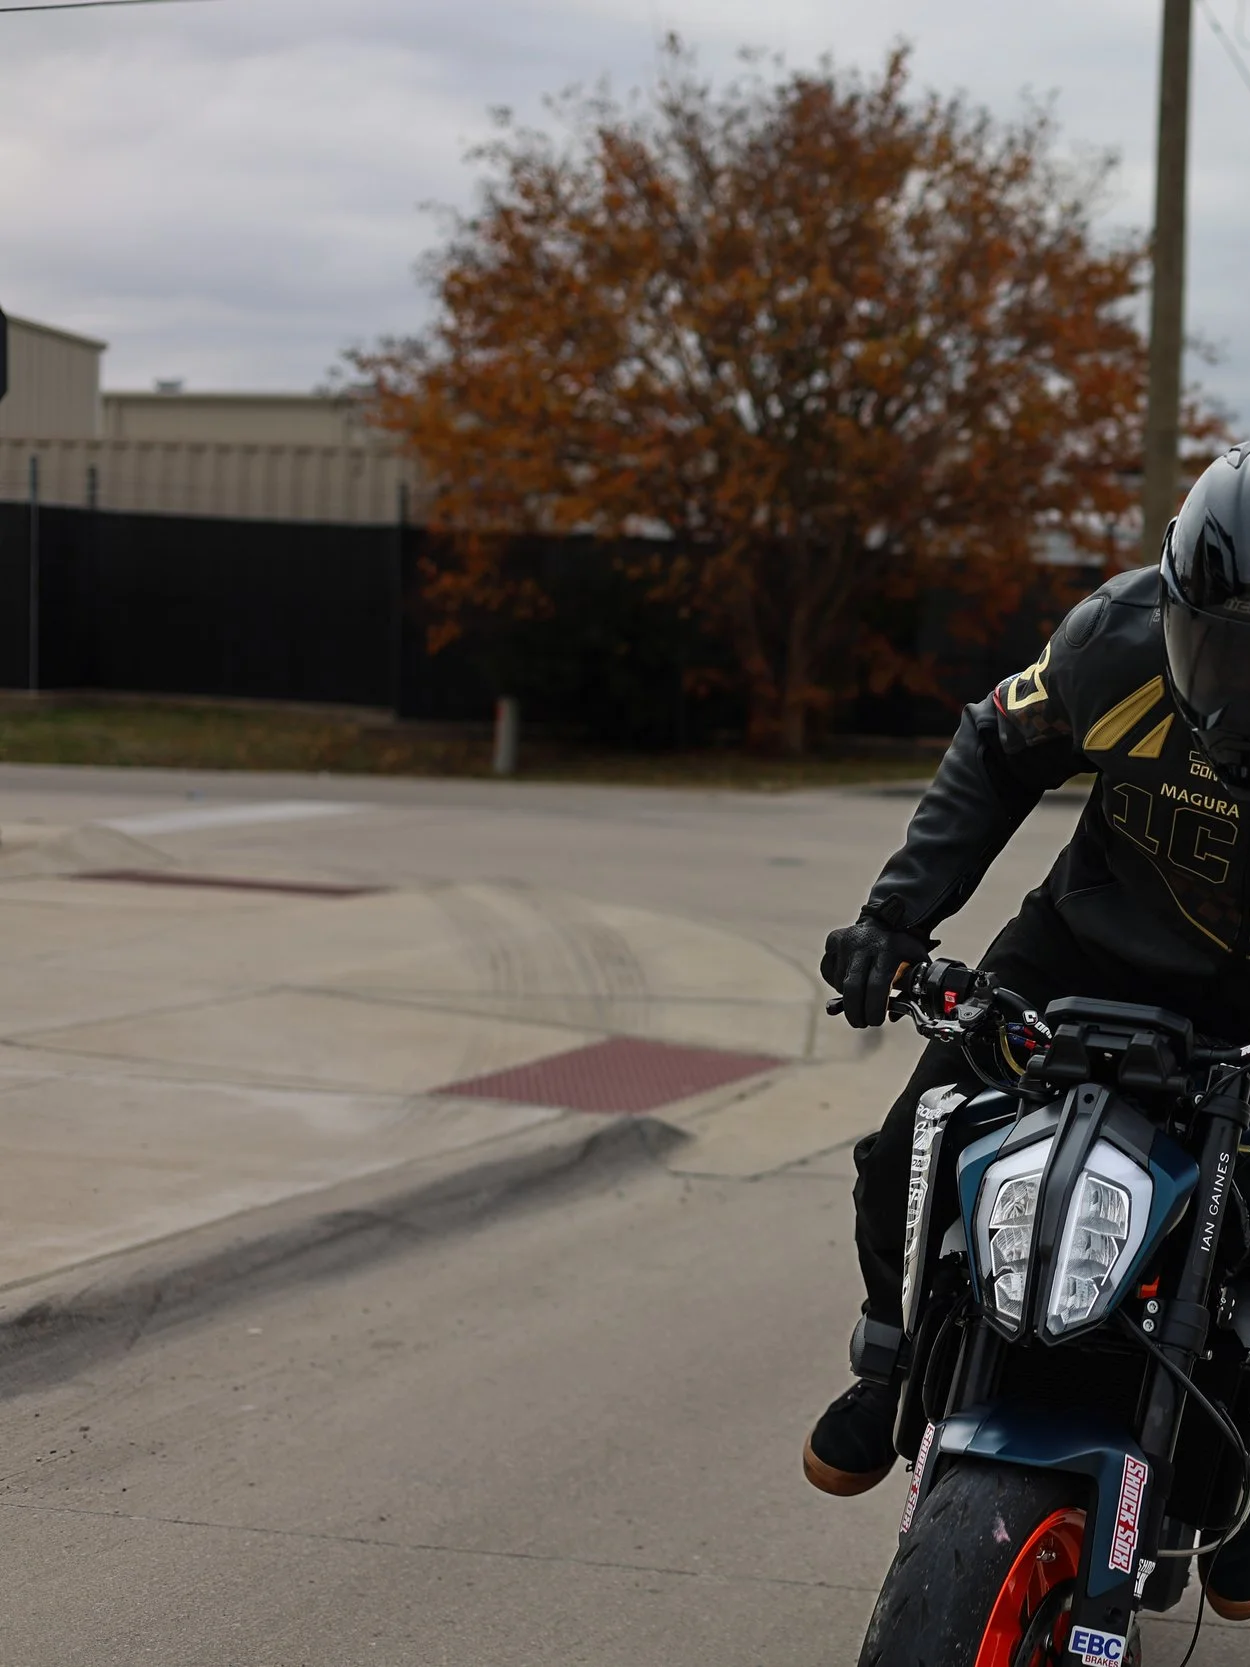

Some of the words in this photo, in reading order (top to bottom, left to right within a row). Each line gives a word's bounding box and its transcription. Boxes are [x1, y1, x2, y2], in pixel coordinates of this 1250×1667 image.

[1160, 783, 1239, 818] MAGURA
[1201, 1222, 1215, 1252] IAN
[1209, 1152, 1230, 1216] GAINES
[1119, 1459, 1144, 1527] SHOCK
[1112, 1525, 1135, 1569] SOX
[1071, 1630, 1122, 1660] EBC
[1085, 1654, 1120, 1667] BRAKES
